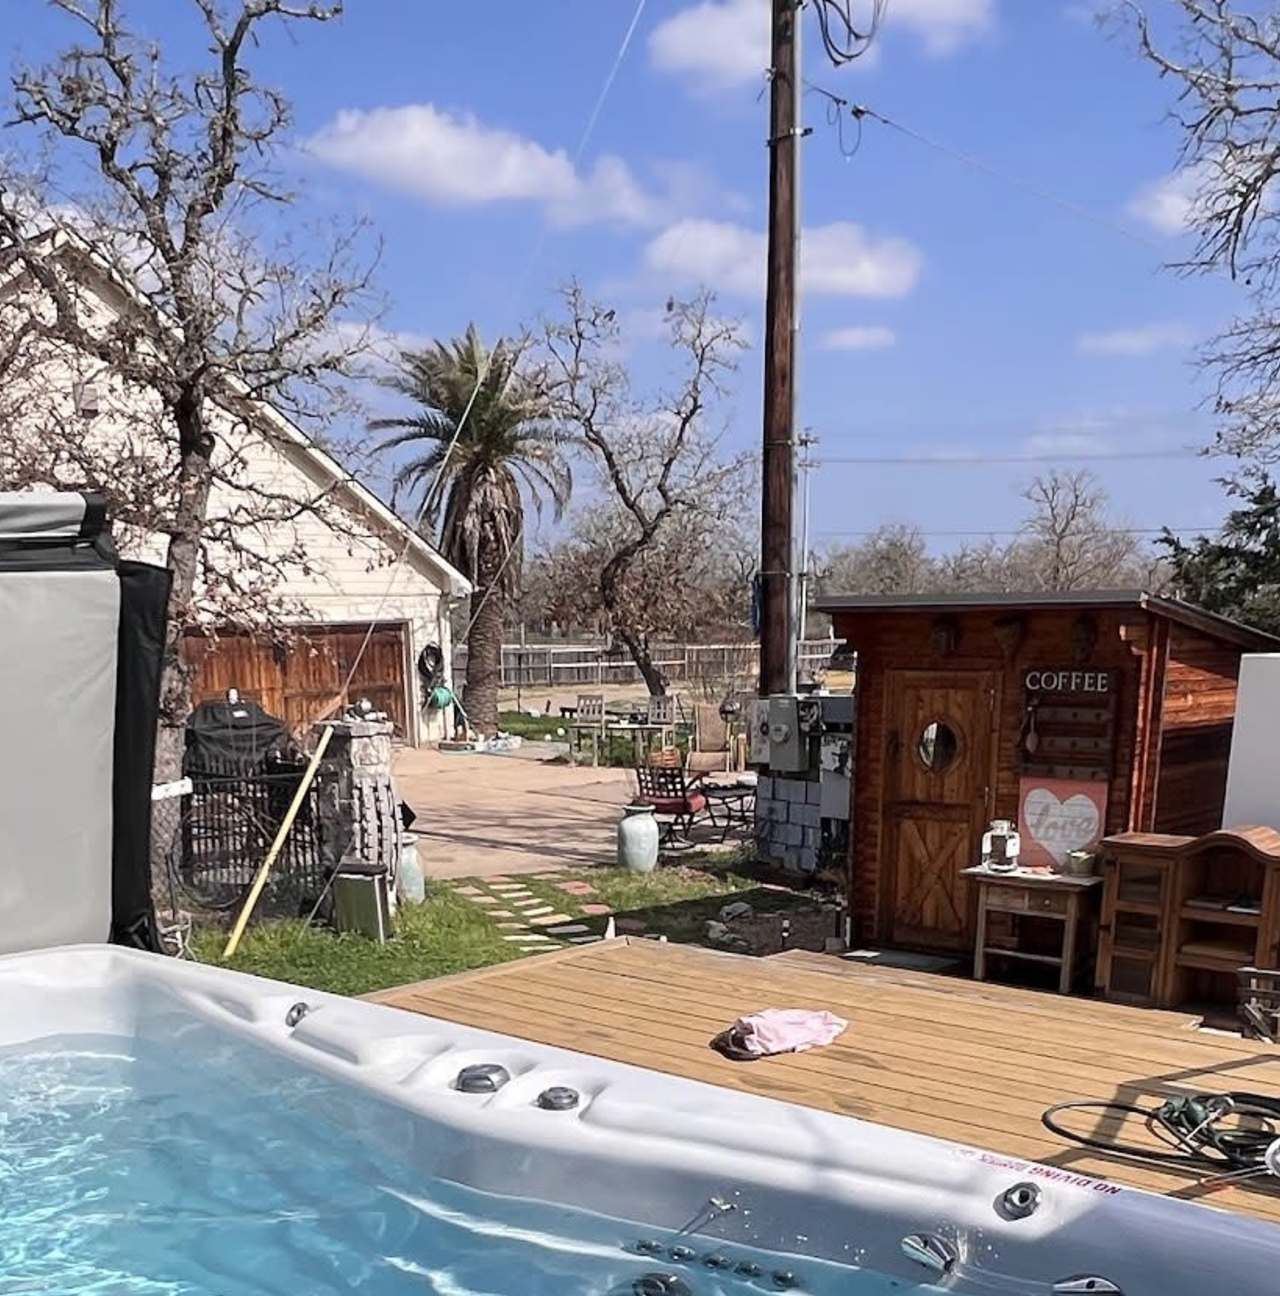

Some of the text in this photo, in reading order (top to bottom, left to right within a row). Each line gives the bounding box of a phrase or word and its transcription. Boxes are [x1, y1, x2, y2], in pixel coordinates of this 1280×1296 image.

[1025, 671, 1109, 692] COFFEE
[1028, 1166, 1122, 1195] NO DIVING
